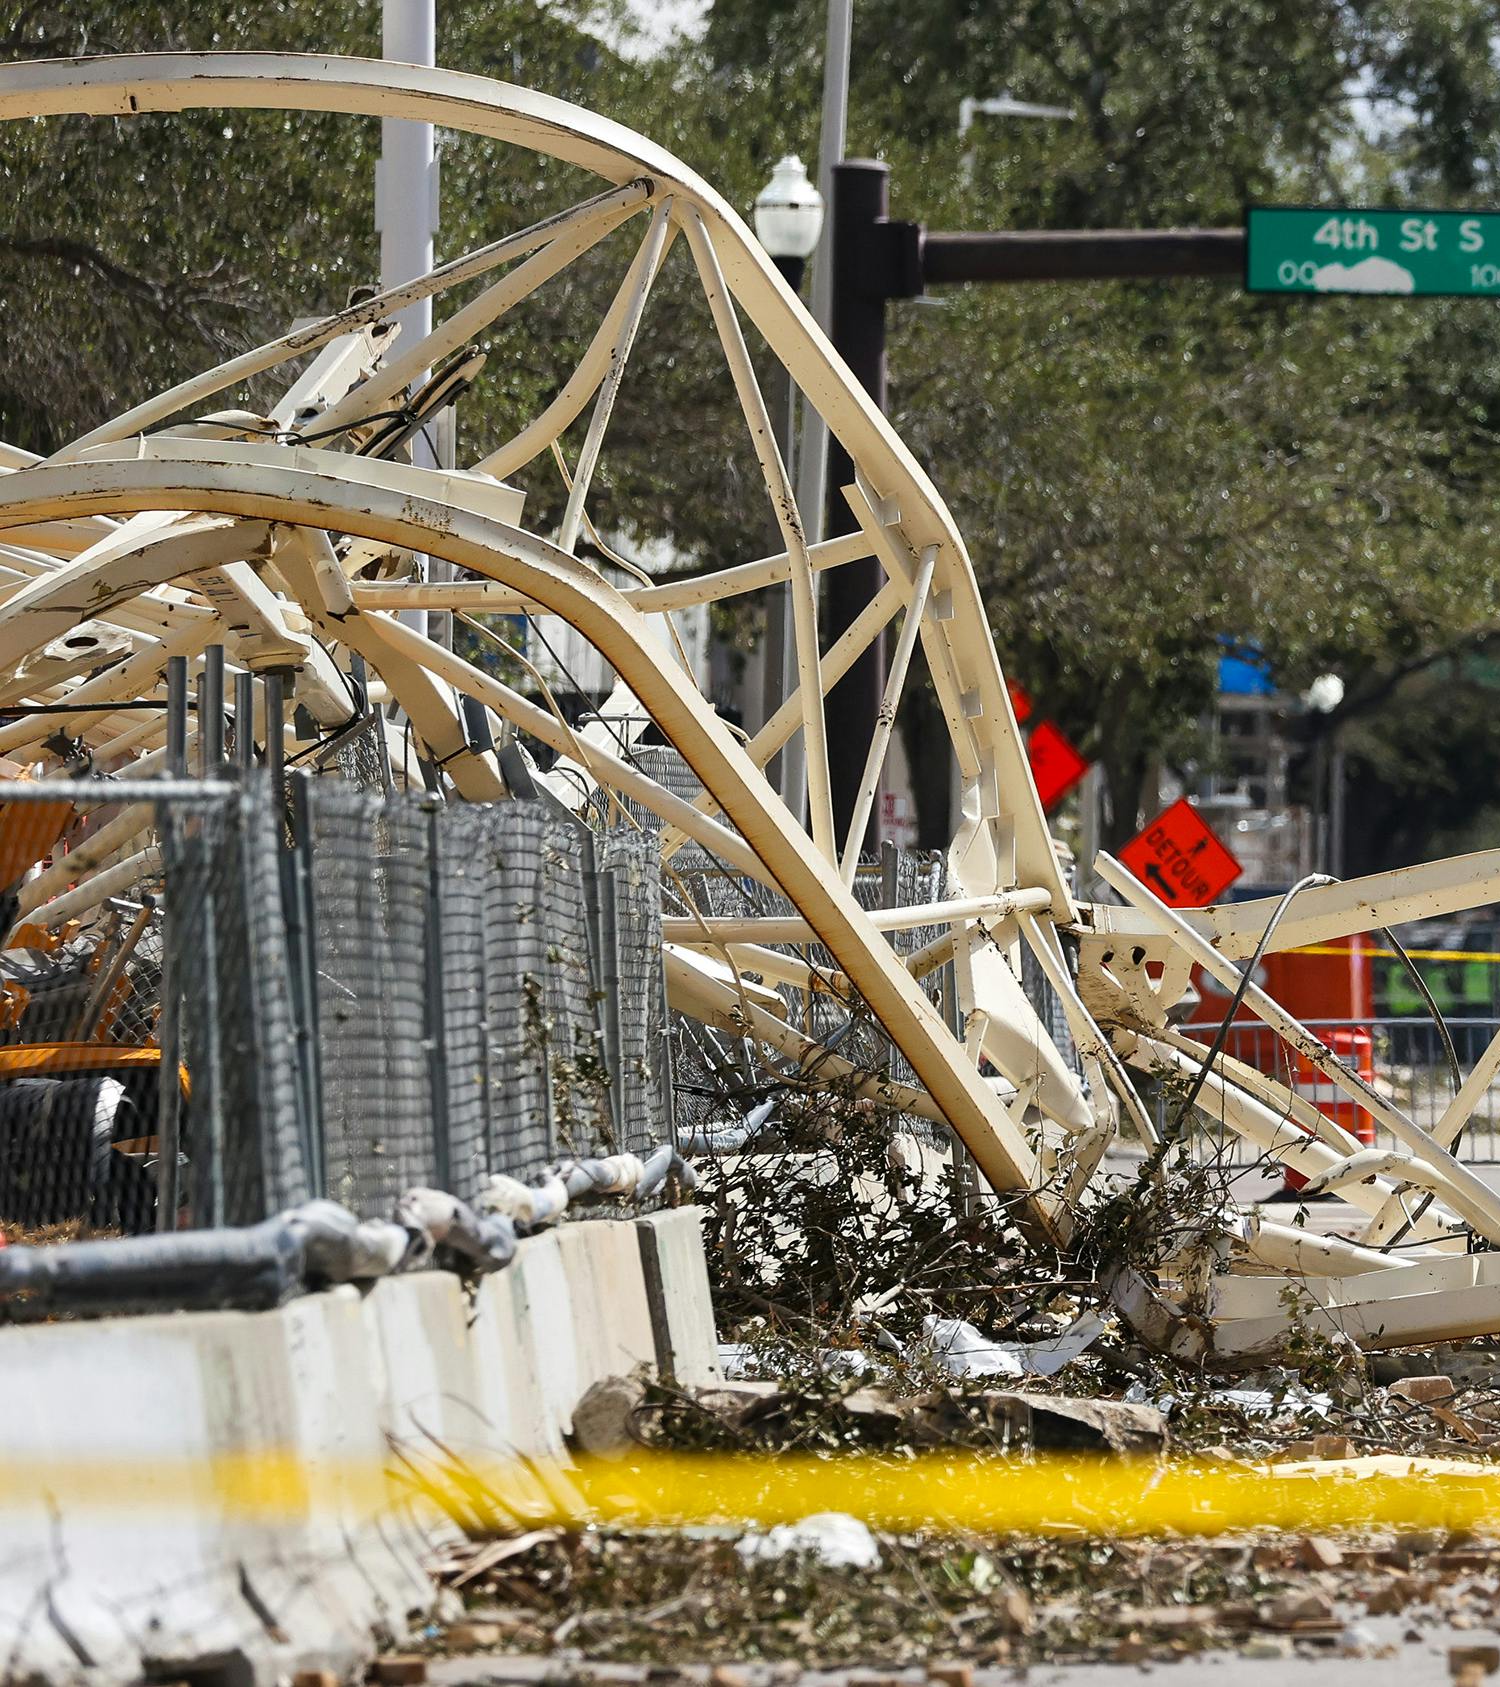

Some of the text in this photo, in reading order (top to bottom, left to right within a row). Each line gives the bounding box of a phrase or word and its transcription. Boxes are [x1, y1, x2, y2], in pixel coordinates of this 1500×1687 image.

[1313, 217, 1485, 252] 4th St S
[1146, 827, 1210, 901] DETOUR
